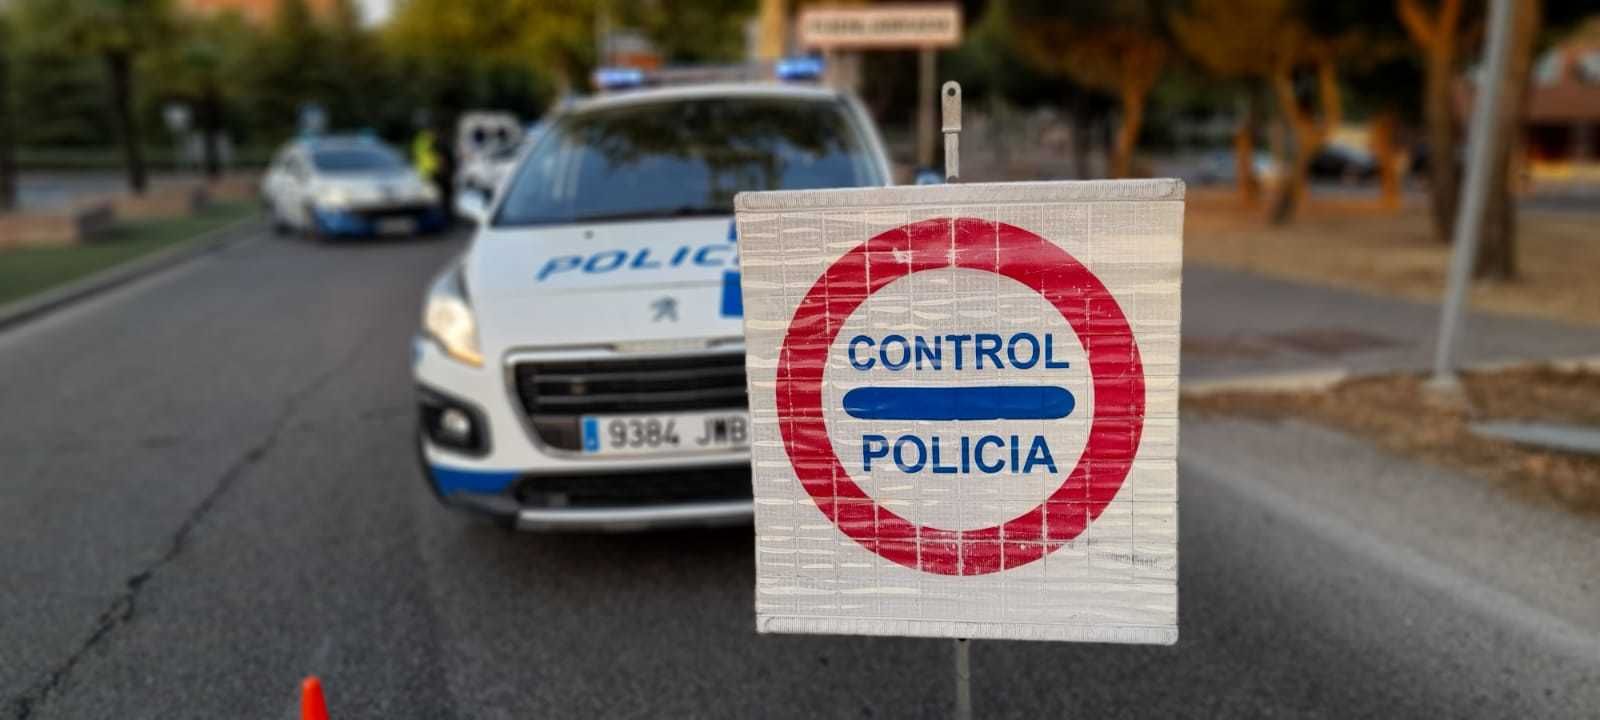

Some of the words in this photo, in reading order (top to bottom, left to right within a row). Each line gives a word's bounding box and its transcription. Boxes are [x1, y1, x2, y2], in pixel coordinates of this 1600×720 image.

[535, 244, 740, 282] POLIC
[848, 332, 1070, 371] CONTROL
[608, 419, 679, 449] 9384
[862, 434, 1058, 474] POLICIA
